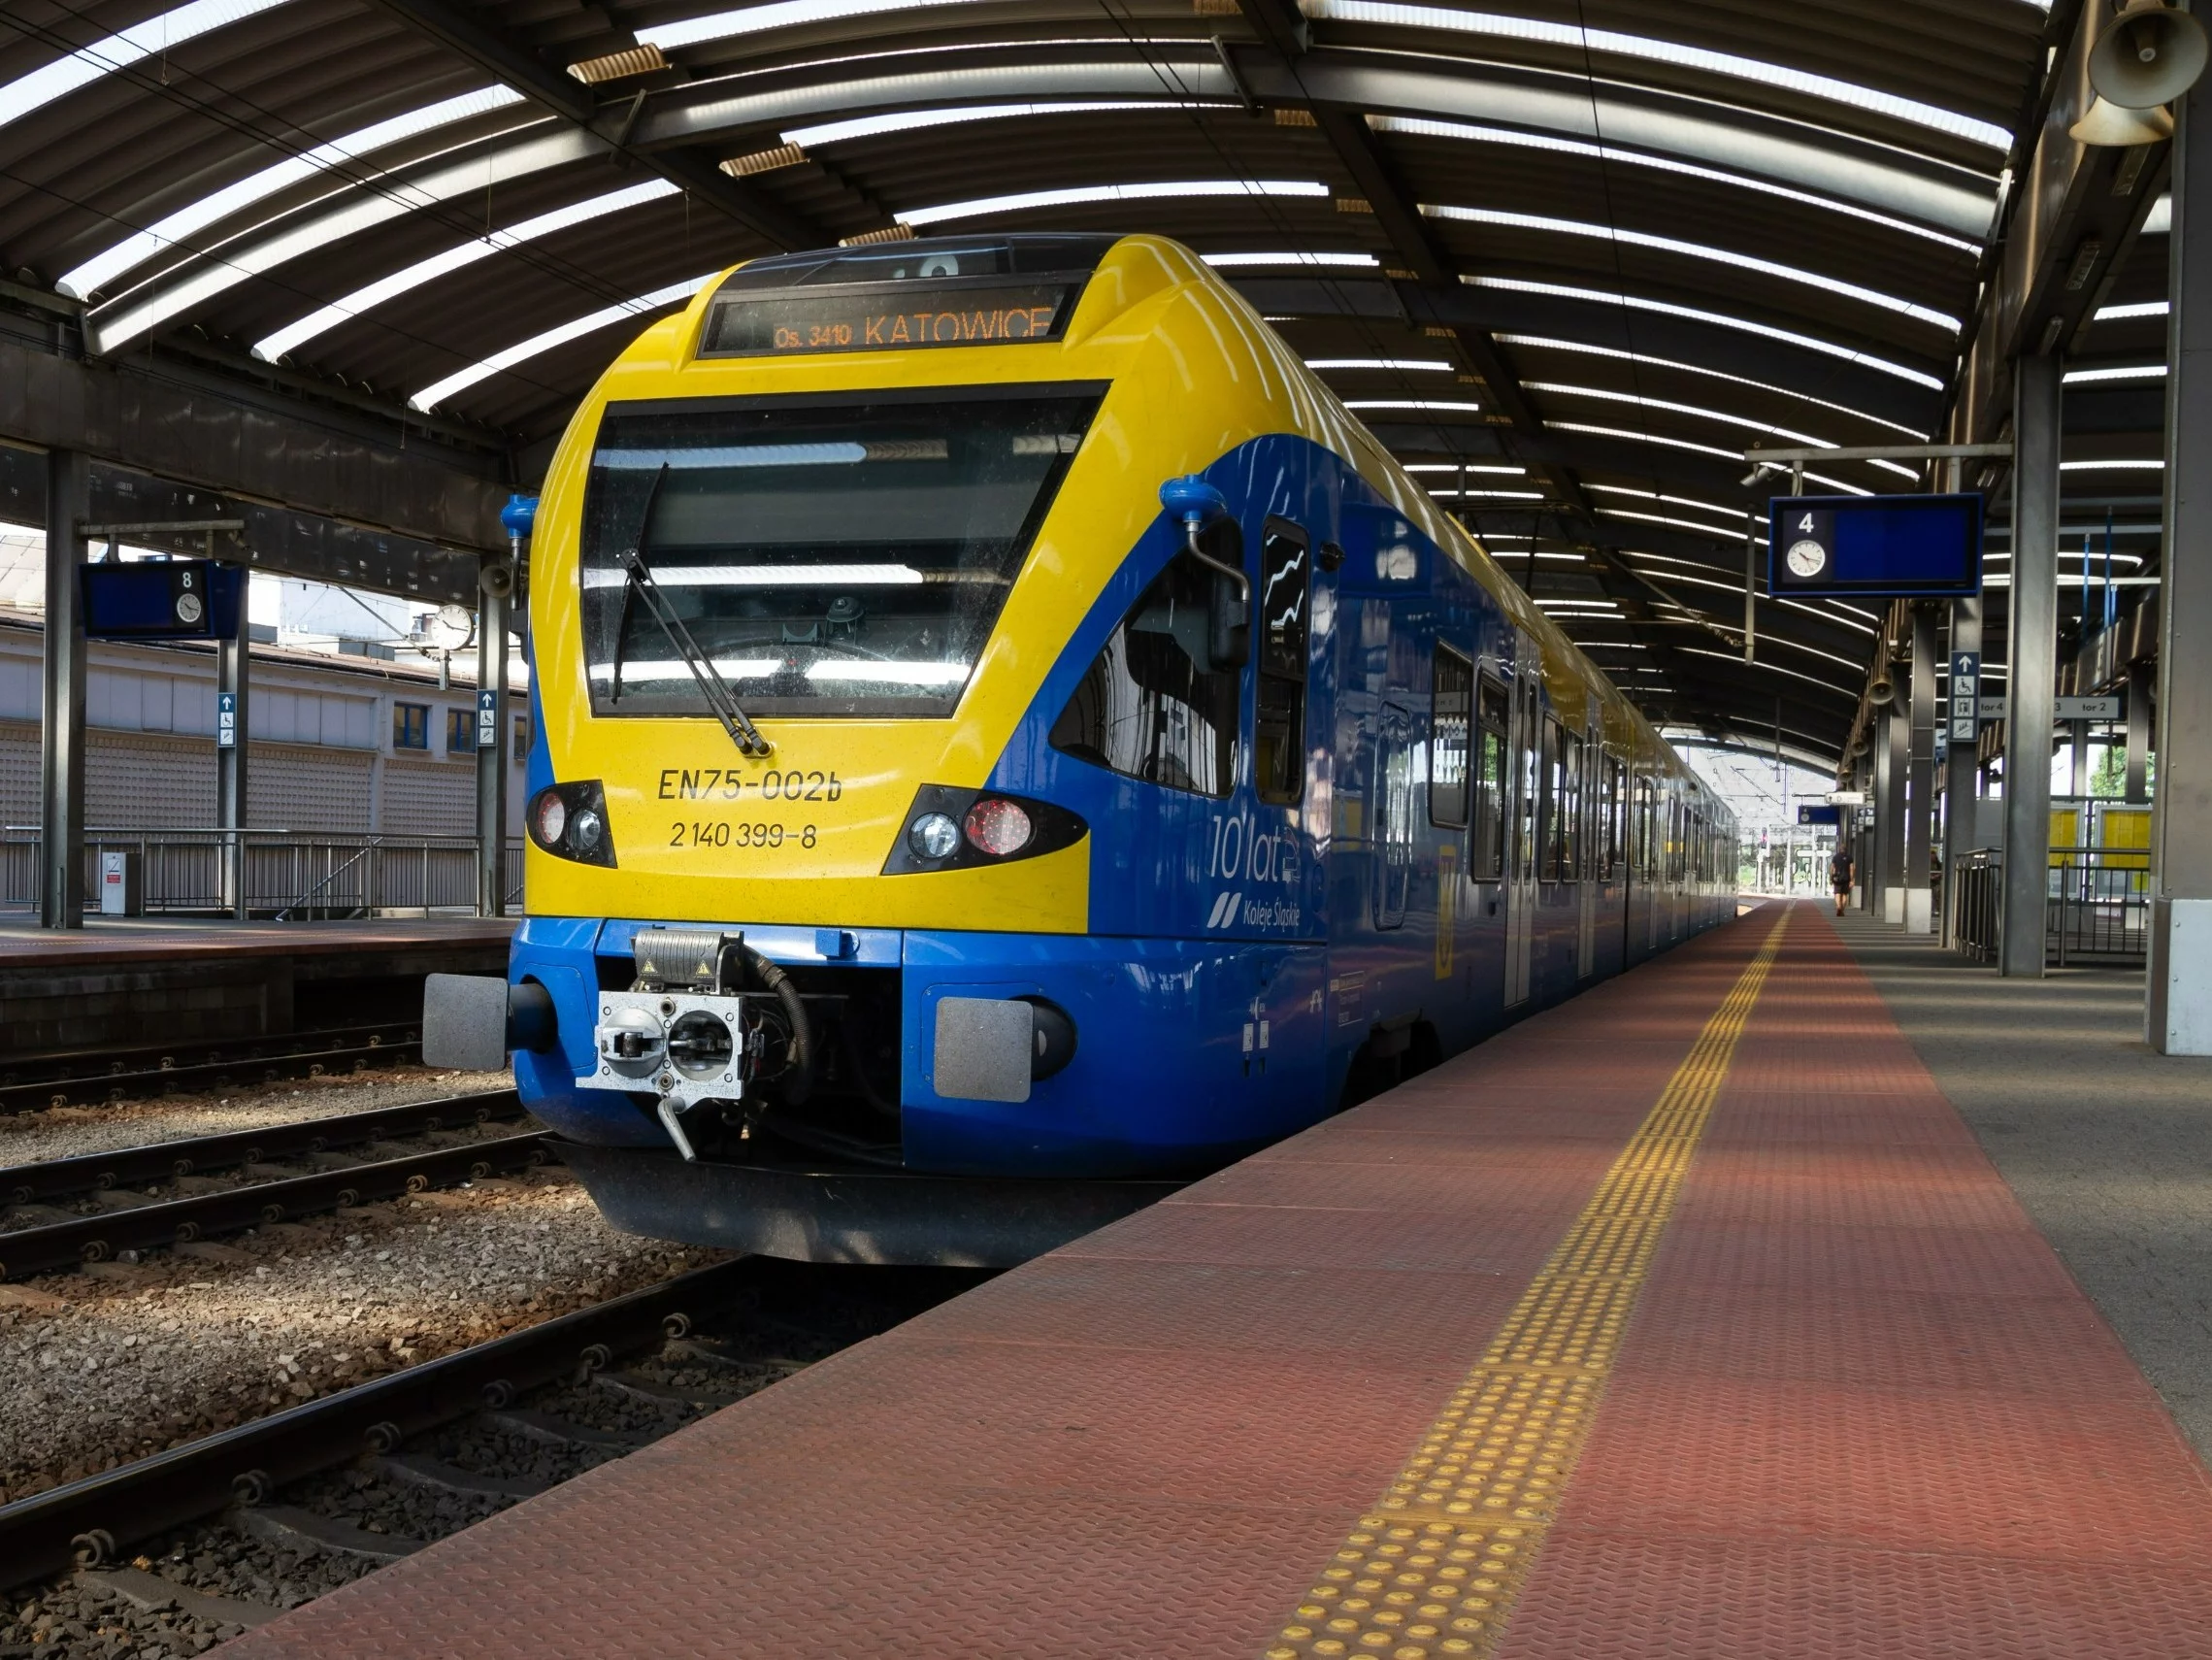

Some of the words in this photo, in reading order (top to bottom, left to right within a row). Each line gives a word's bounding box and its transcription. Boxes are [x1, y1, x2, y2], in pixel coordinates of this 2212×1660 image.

[809, 323, 852, 347] 3410
[1799, 513, 1814, 533] 4
[182, 572, 192, 588] 8
[1997, 702, 2003, 711] 4
[2055, 703, 2062, 712] 3
[2099, 703, 2106, 712] 2
[658, 769, 842, 802] EN75-002b
[692, 822, 730, 847] 140
[736, 823, 817, 849] 399-8
[1210, 815, 1241, 879] 10
[1245, 813, 1281, 882] lat
[1243, 900, 1272, 933] Koleje
[1273, 896, 1301, 933] Śląskie
